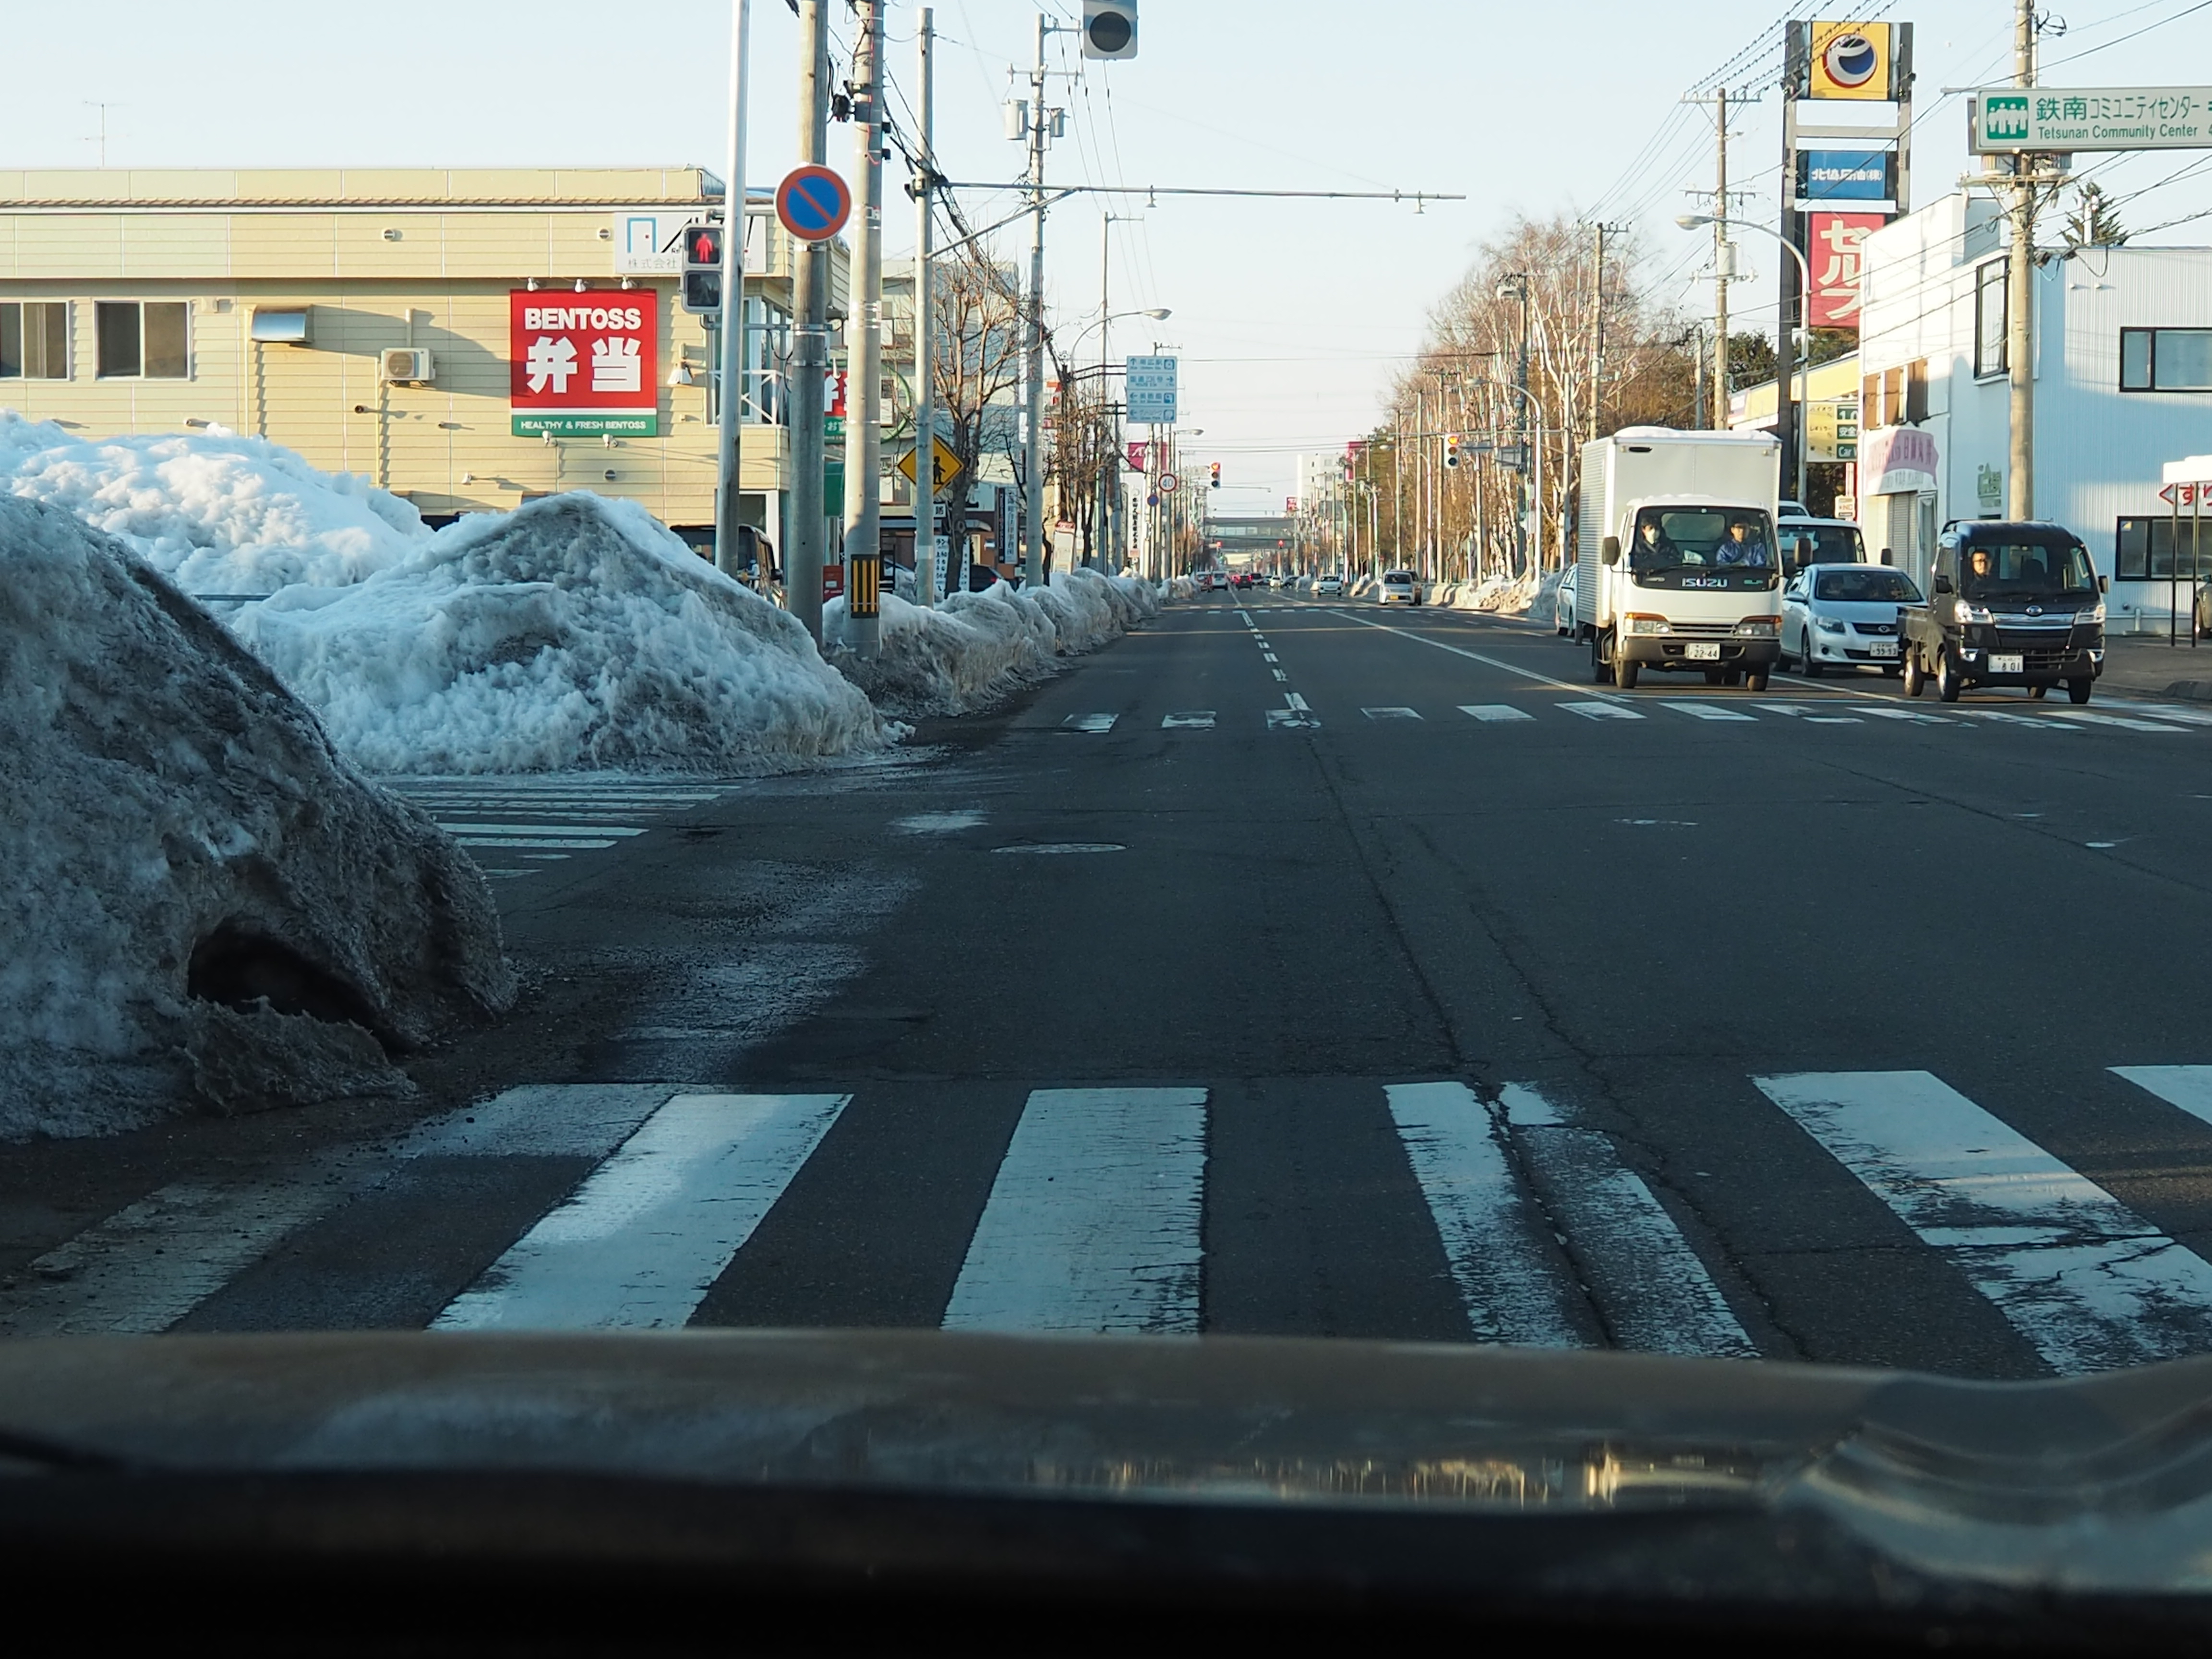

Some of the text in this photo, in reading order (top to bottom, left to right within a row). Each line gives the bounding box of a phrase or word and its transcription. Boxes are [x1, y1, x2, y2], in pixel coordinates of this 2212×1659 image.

[2036, 96, 2200, 120] 鉄南コミュニティセンター
[2039, 126, 2088, 139] Tetsunan
[2092, 124, 2156, 140] Community
[2160, 123, 2198, 137] Center
[628, 258, 680, 269] 株式会社
[525, 307, 642, 330] BENTOSS
[526, 336, 641, 394] 弁当
[521, 421, 646, 429] HEALTHY & FRESH BENTOSS
[1162, 478, 1173, 487] 40
[1682, 577, 1727, 588] ISUZU
